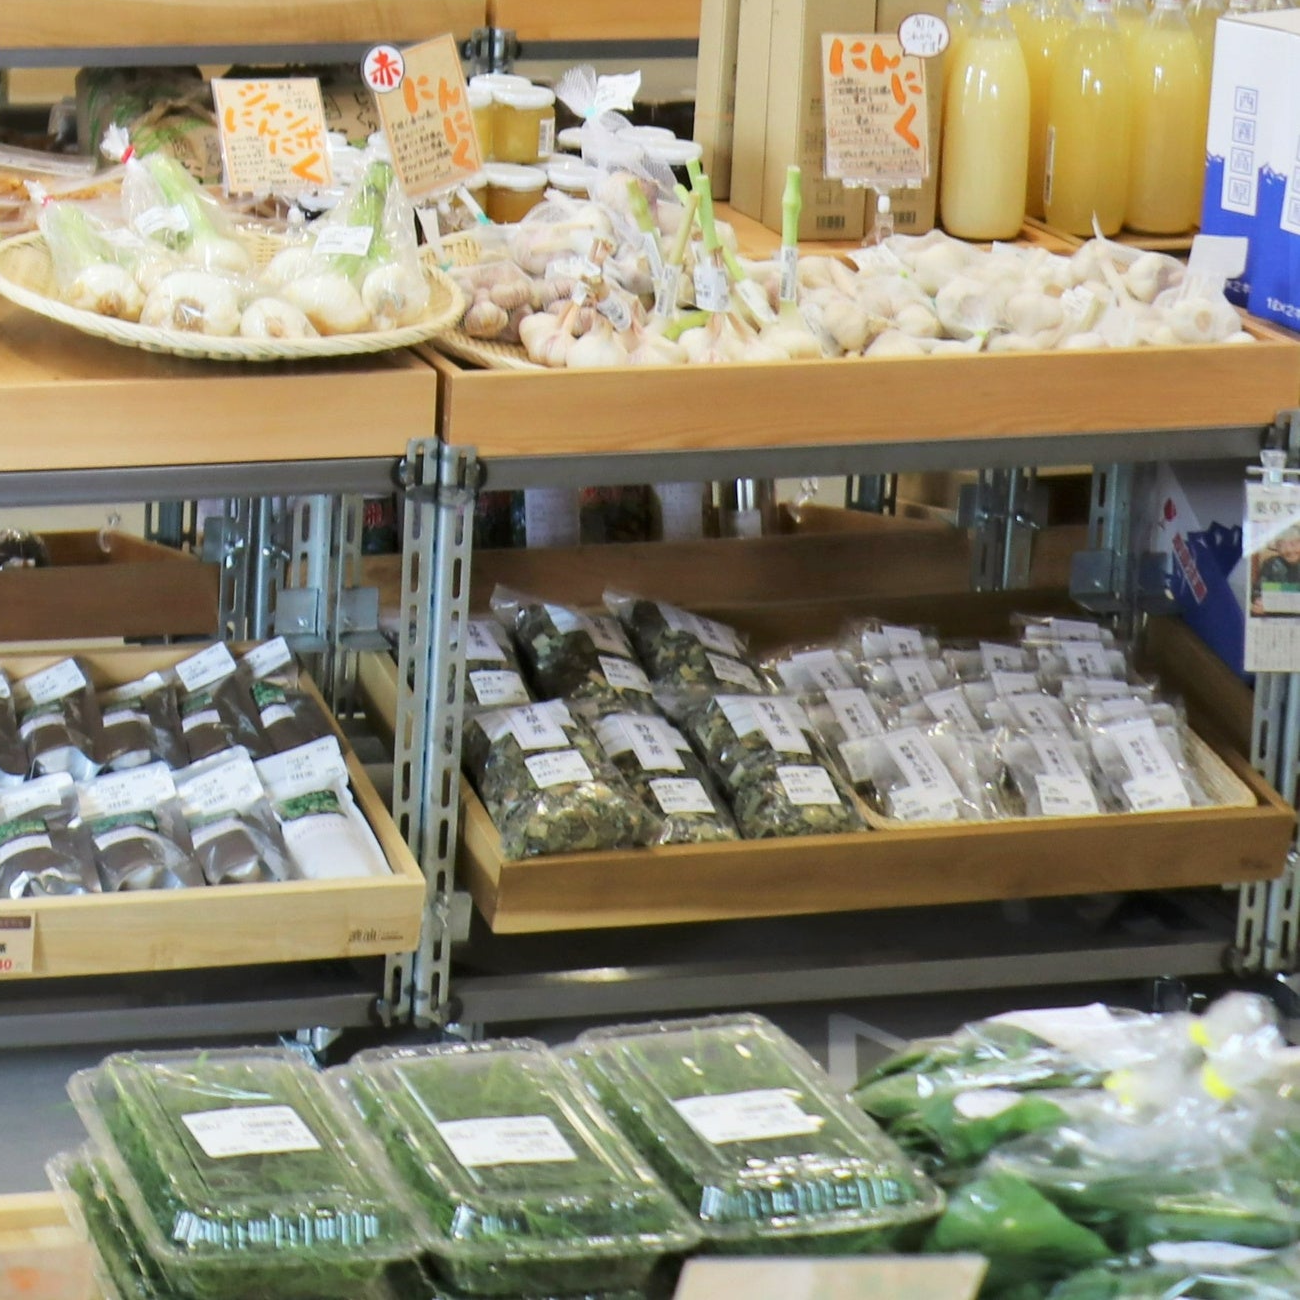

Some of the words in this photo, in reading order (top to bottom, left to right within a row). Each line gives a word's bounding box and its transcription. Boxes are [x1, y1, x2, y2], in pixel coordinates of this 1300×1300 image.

[369, 49, 401, 87] 赤
[829, 38, 923, 150] にんにく
[403, 74, 478, 172] にんにく
